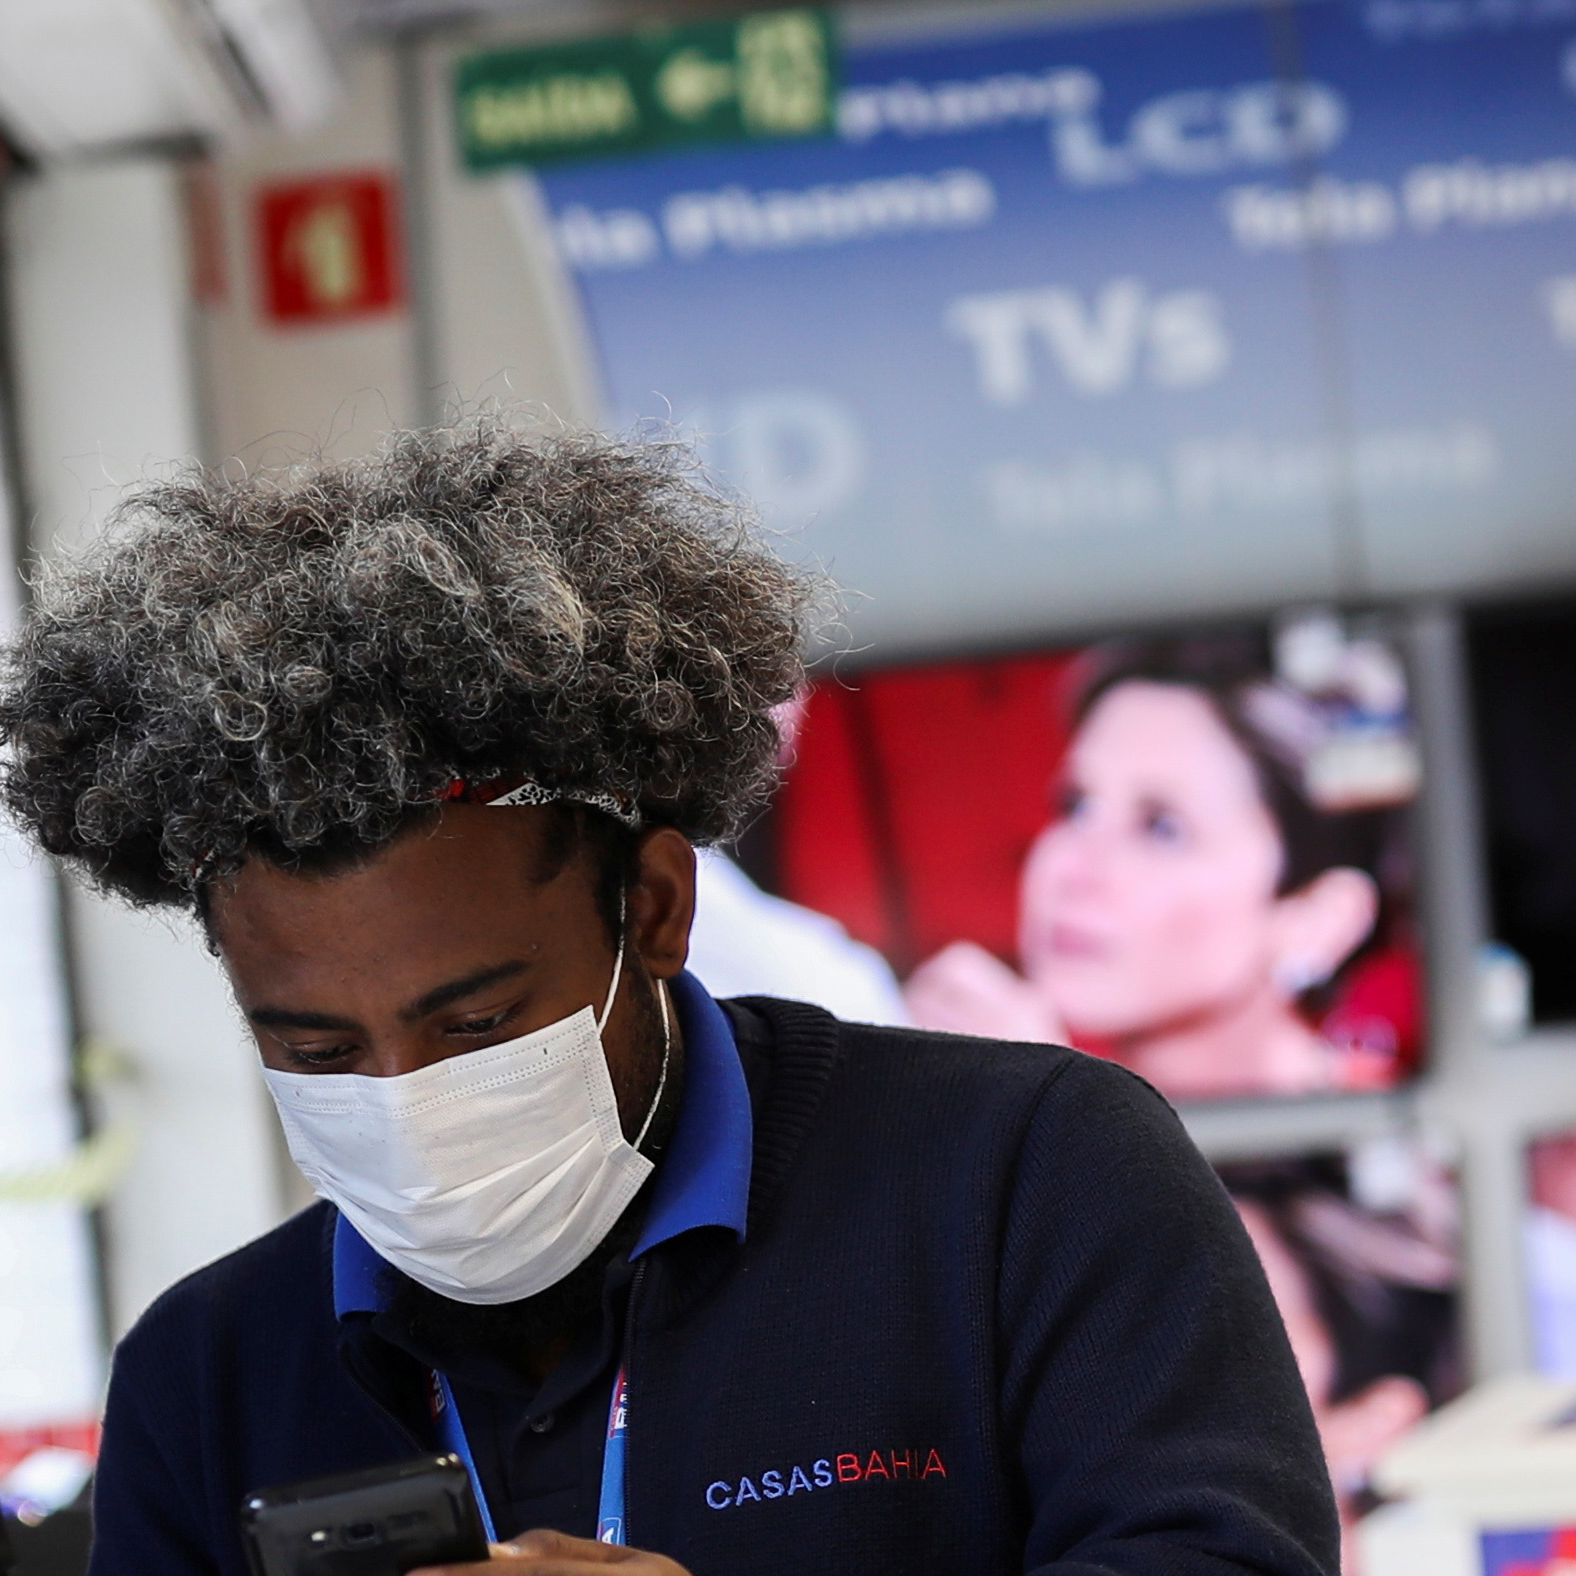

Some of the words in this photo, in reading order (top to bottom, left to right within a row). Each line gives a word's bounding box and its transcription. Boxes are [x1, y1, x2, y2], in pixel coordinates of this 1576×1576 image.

[1055, 82, 1341, 186] LCD
[665, 170, 994, 257] Plasma
[1226, 180, 1393, 248] Tela
[951, 283, 1225, 400] TVs
